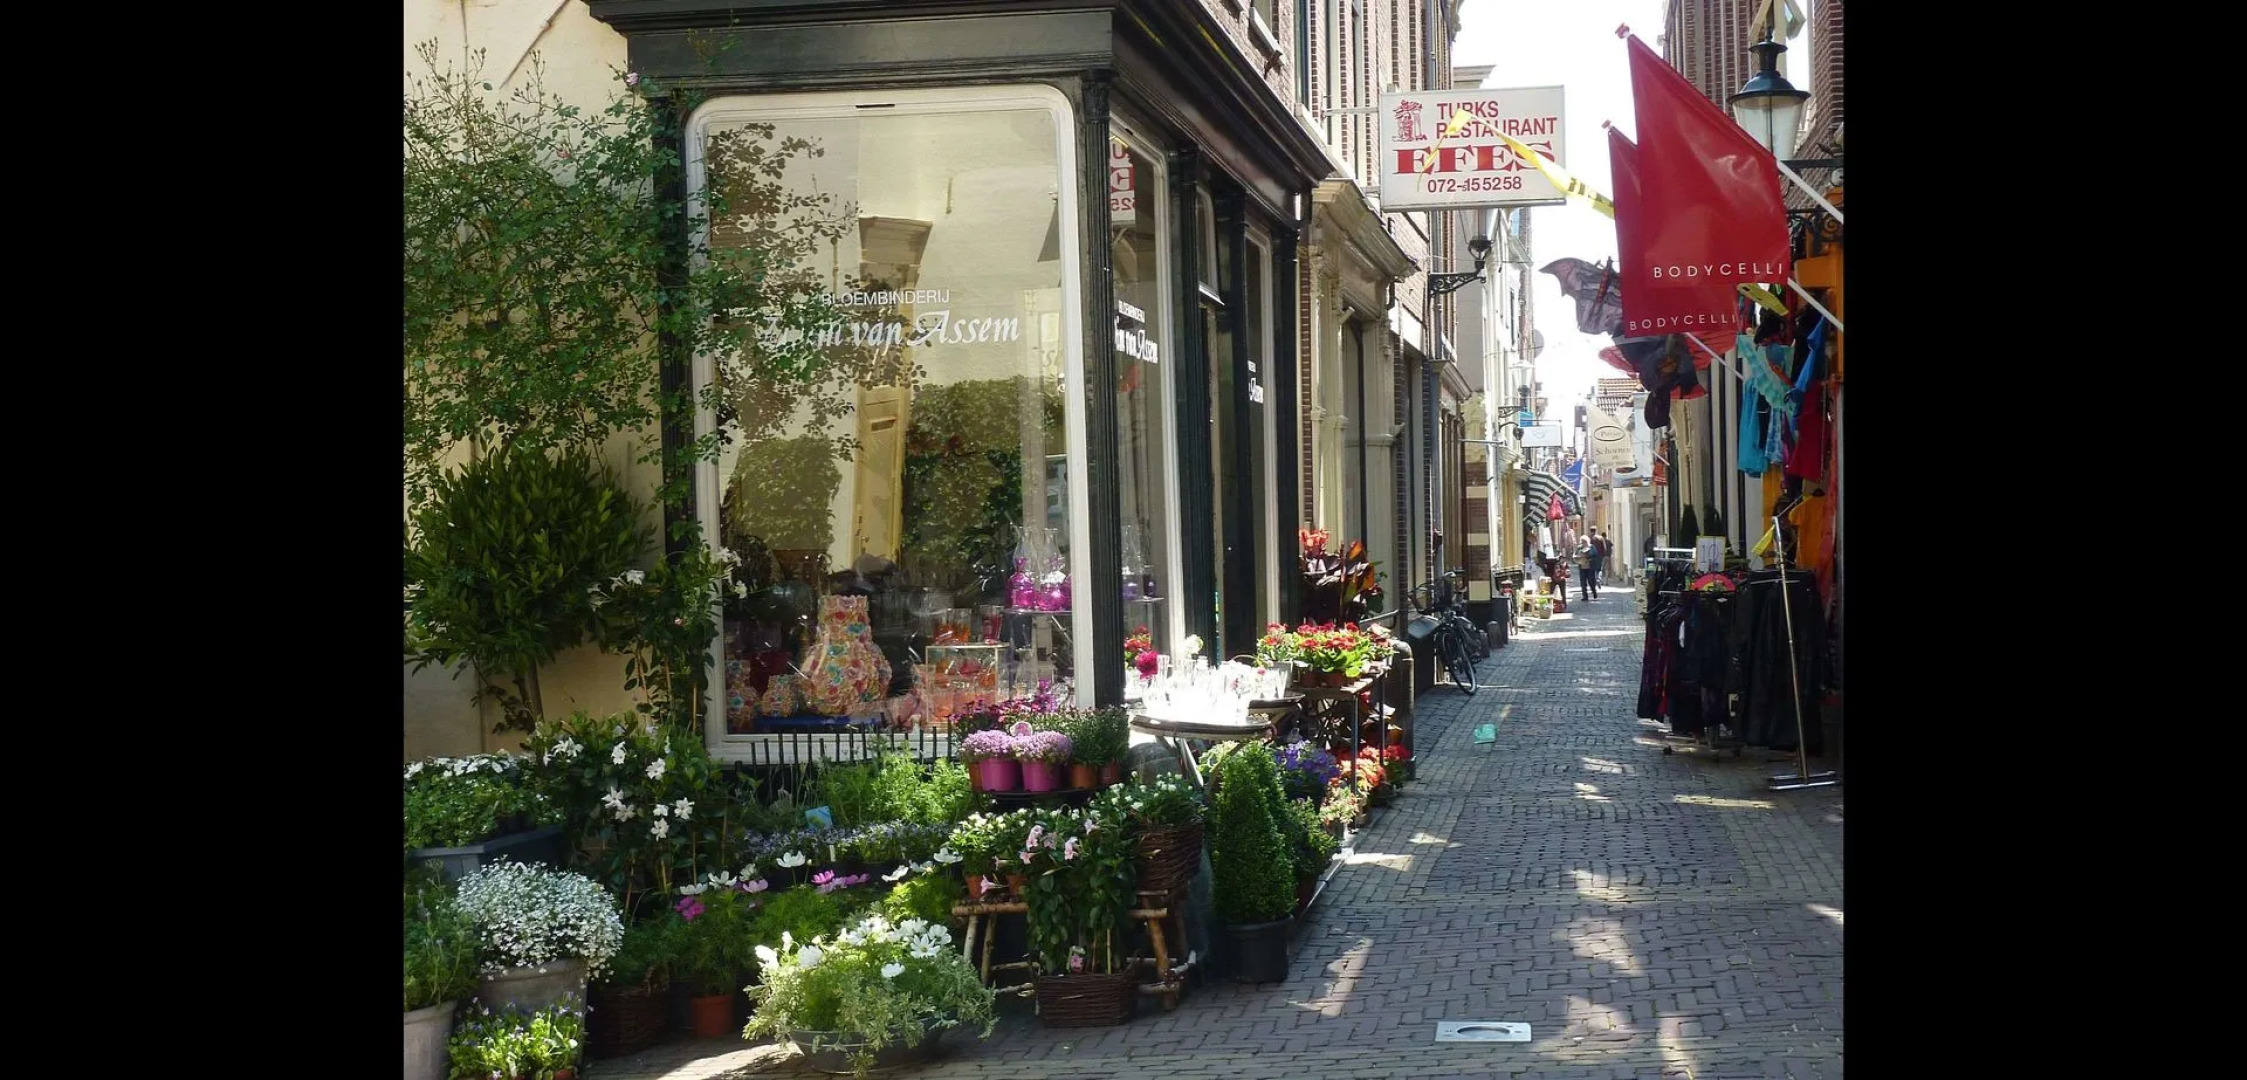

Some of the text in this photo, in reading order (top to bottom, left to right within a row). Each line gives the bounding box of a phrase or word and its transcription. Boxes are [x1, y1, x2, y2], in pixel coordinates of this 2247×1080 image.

[1437, 101, 1499, 120] TURKS
[1393, 140, 1556, 175] EFES
[1653, 262, 1783, 279] BODYCELLI
[821, 289, 950, 307] BLOEMBINDERIJ
[851, 319, 902, 347] van
[907, 309, 1020, 346] Assem
[1629, 314, 1736, 331] BODYCELLI
